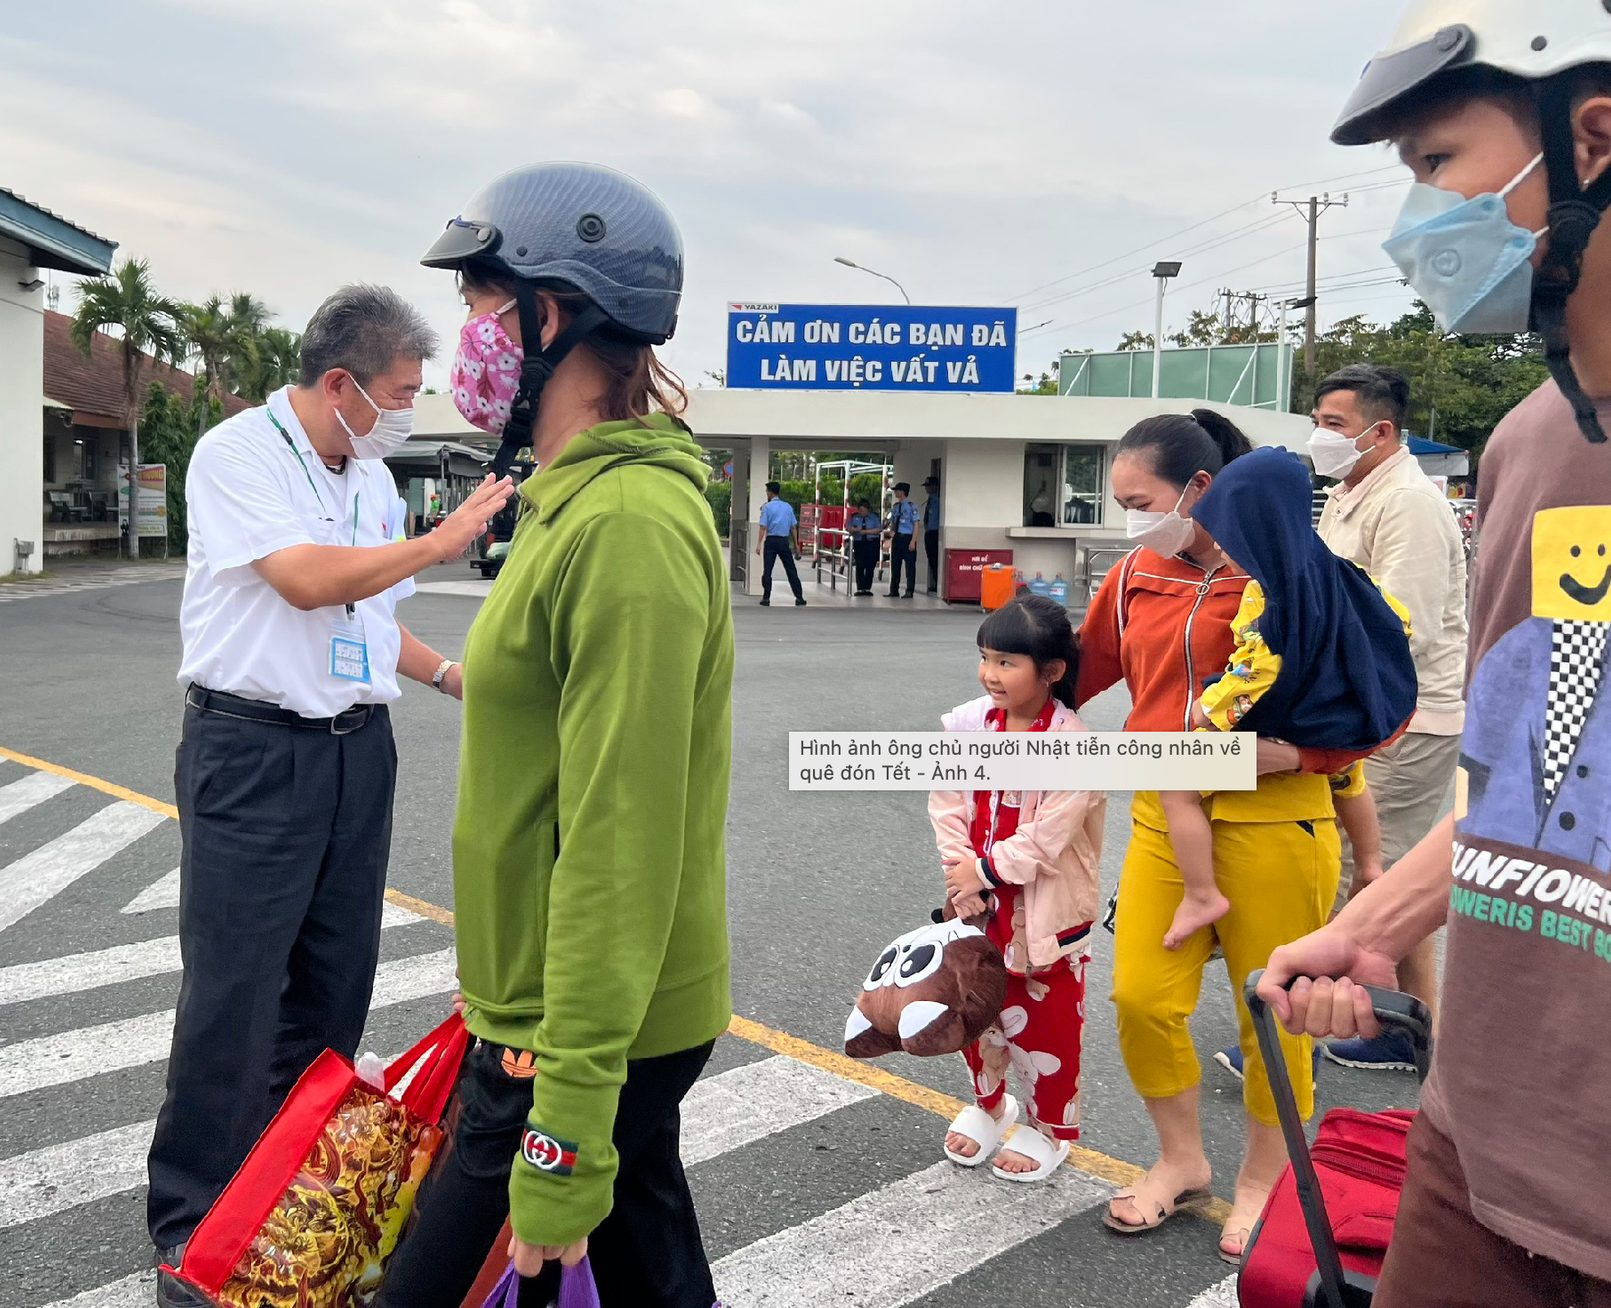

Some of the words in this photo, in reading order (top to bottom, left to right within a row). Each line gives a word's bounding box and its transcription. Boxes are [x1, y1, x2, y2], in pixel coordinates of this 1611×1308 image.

[736, 314, 795, 343] CẢM
[804, 319, 840, 343] ƠN
[848, 318, 901, 345] CÁC
[909, 323, 963, 350] BẠN
[971, 320, 1007, 347] ĐÃ
[760, 354, 817, 381] LÀM
[825, 355, 882, 387] VIỆC
[890, 353, 939, 383] VẤT
[947, 355, 979, 384] VẢ
[1541, 909, 1592, 950] BEST
